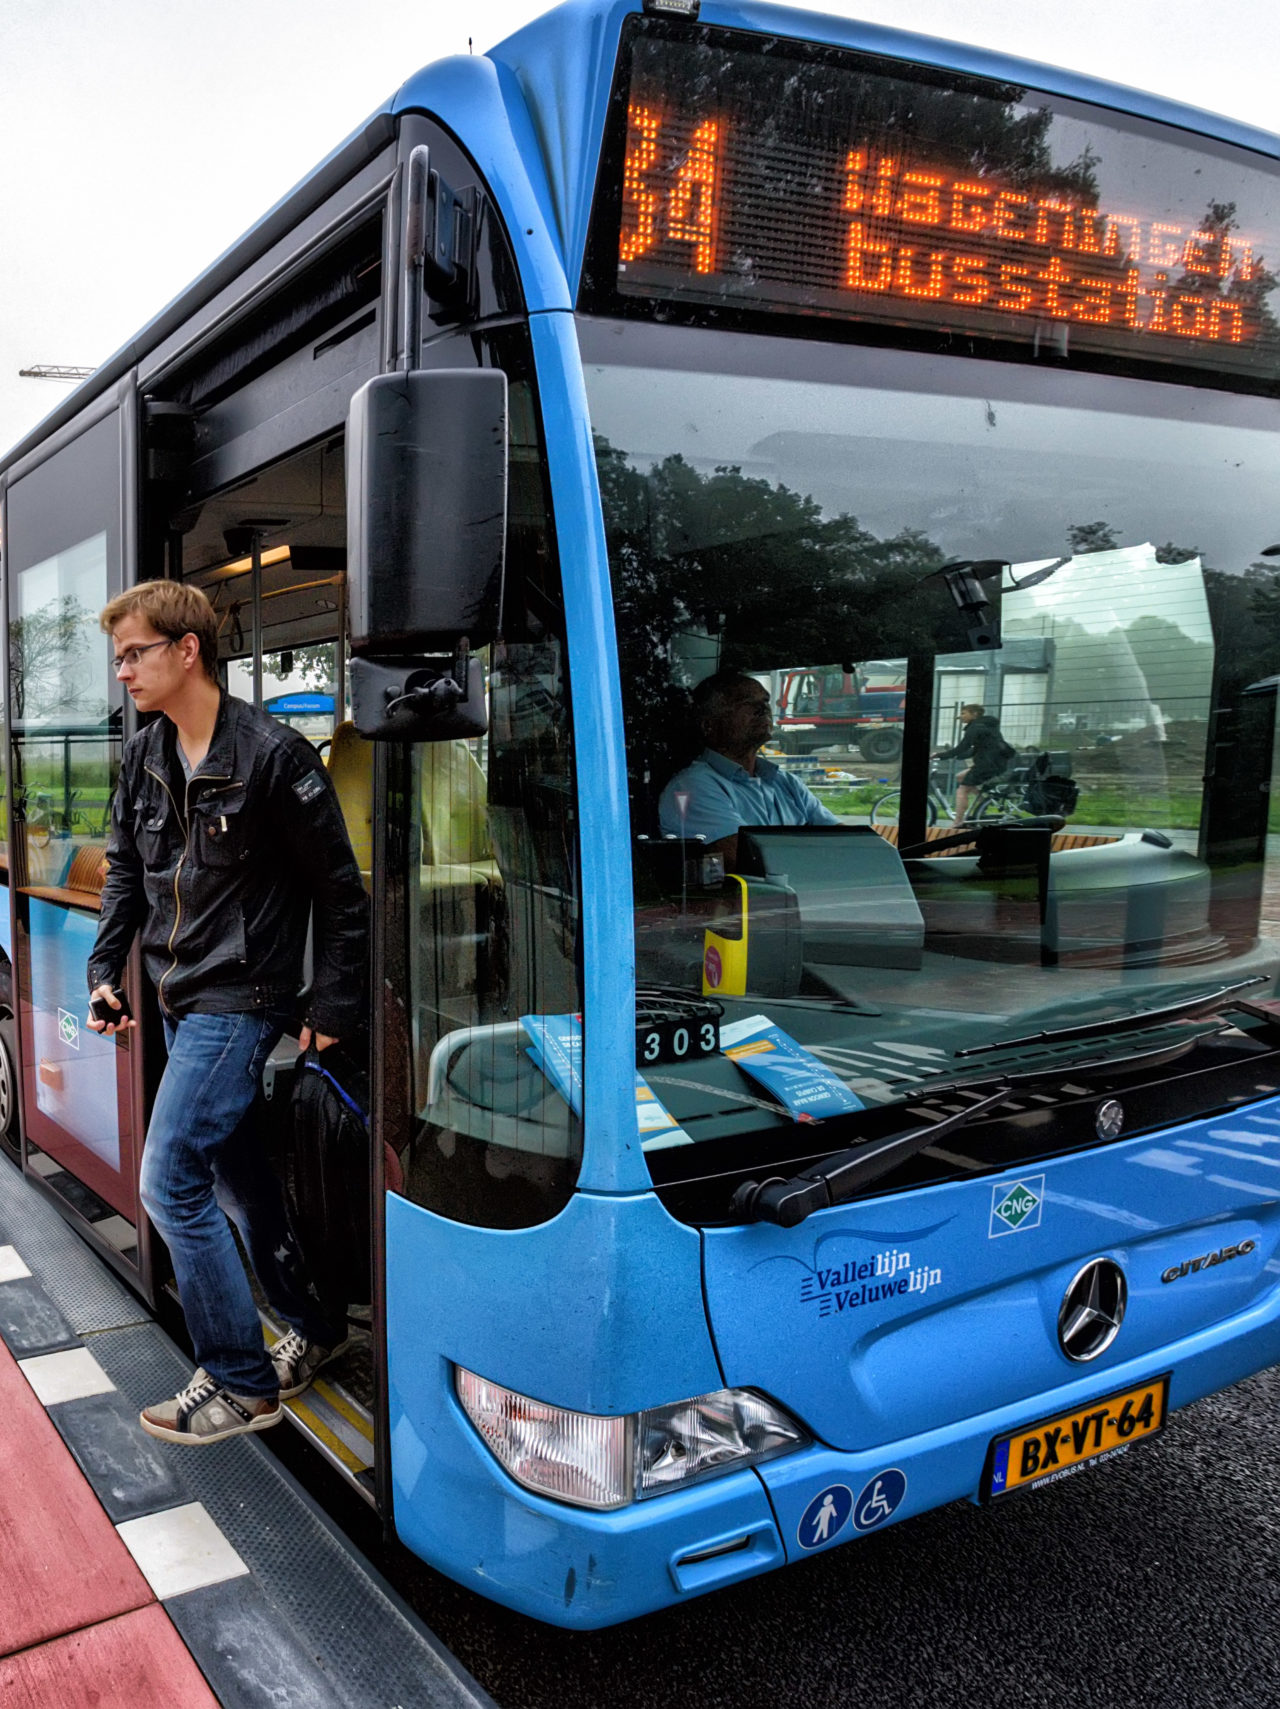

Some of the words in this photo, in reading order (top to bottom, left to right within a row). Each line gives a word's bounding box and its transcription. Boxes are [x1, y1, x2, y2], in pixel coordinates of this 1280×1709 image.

[846, 221, 1243, 343] busstation
[999, 1195, 1034, 1218] CNG
[816, 1249, 911, 1290] Valleilijn
[1161, 1239, 1256, 1284] CITARO
[834, 1266, 942, 1312] Veluwelijn
[1020, 1393, 1154, 1477] BX-VT-64
